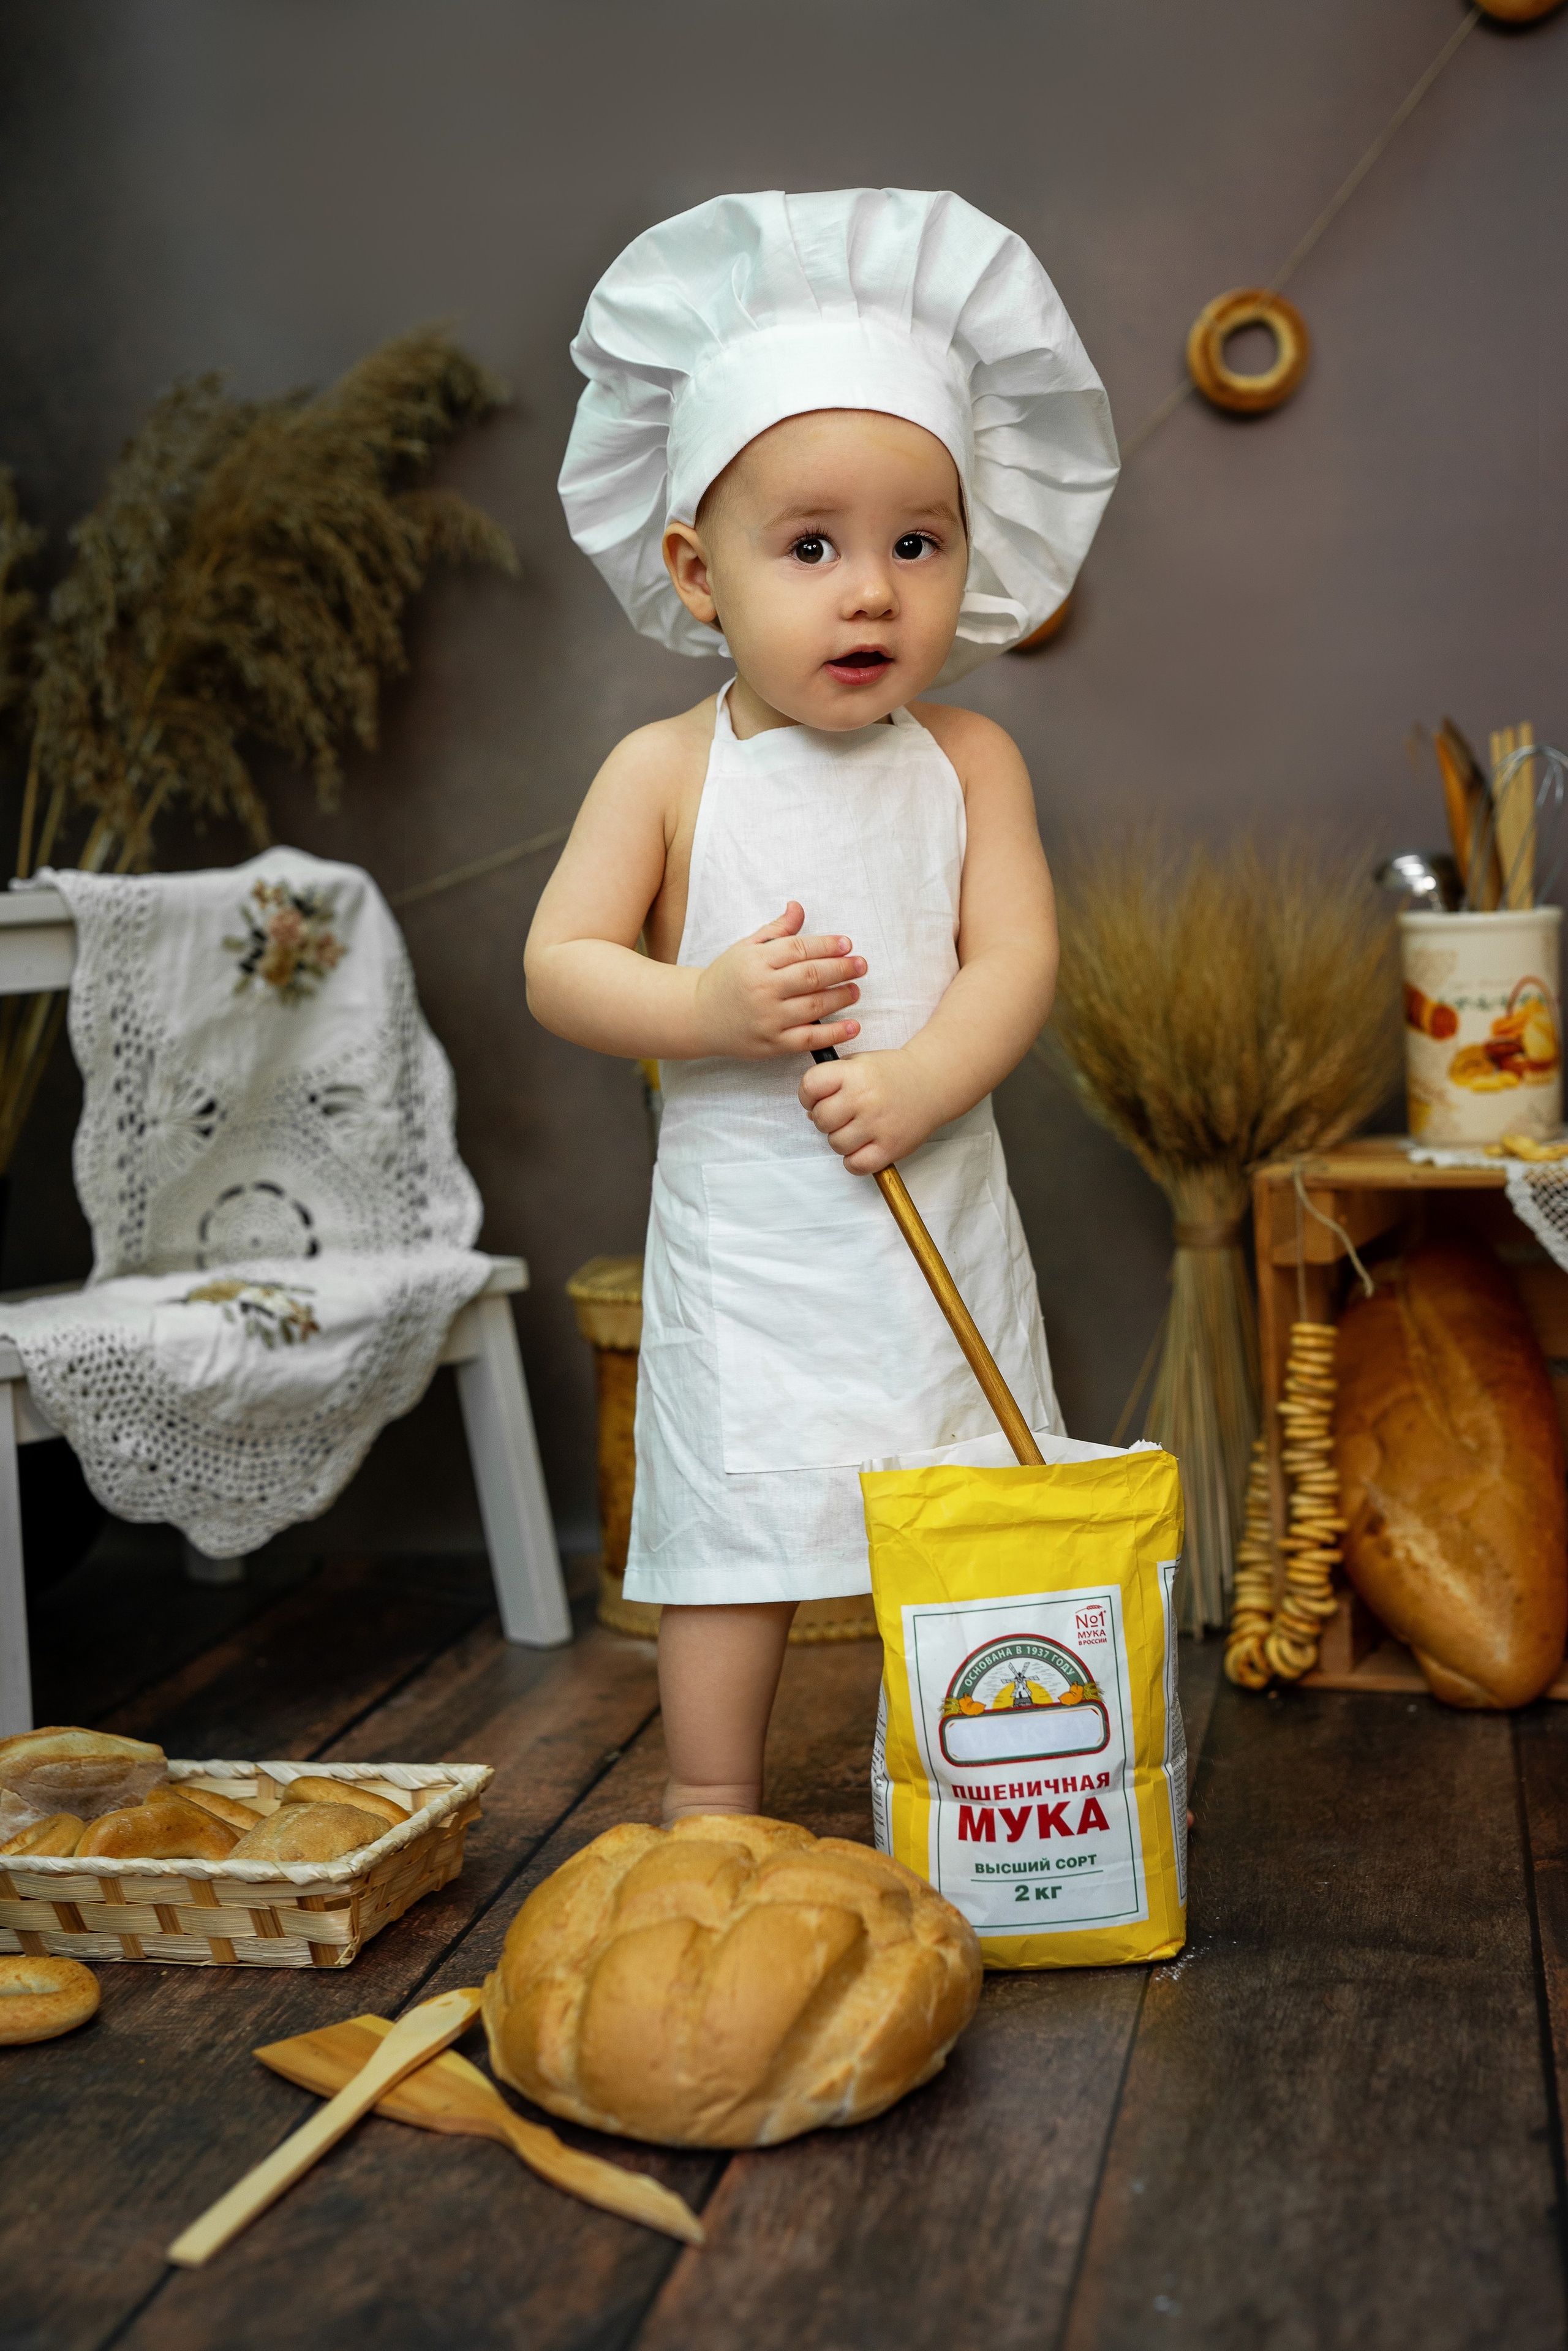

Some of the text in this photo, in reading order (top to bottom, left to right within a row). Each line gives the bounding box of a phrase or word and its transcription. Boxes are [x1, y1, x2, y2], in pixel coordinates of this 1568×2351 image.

[1077, 1629, 1106, 1639] МУКА
[964, 1647, 1013, 1687] ОСНОВАНА
[1026, 1646, 1050, 1659] 1937
[1051, 1654, 1076, 1676] ГОДУ
[951, 1772, 1110, 1801] ПШЕНИЧНАЯ
[958, 1796, 1110, 1843] МУКА
[974, 1854, 1097, 1874] ВЫСШИЙ СОРТ
[1014, 1884, 1030, 1902] 2
